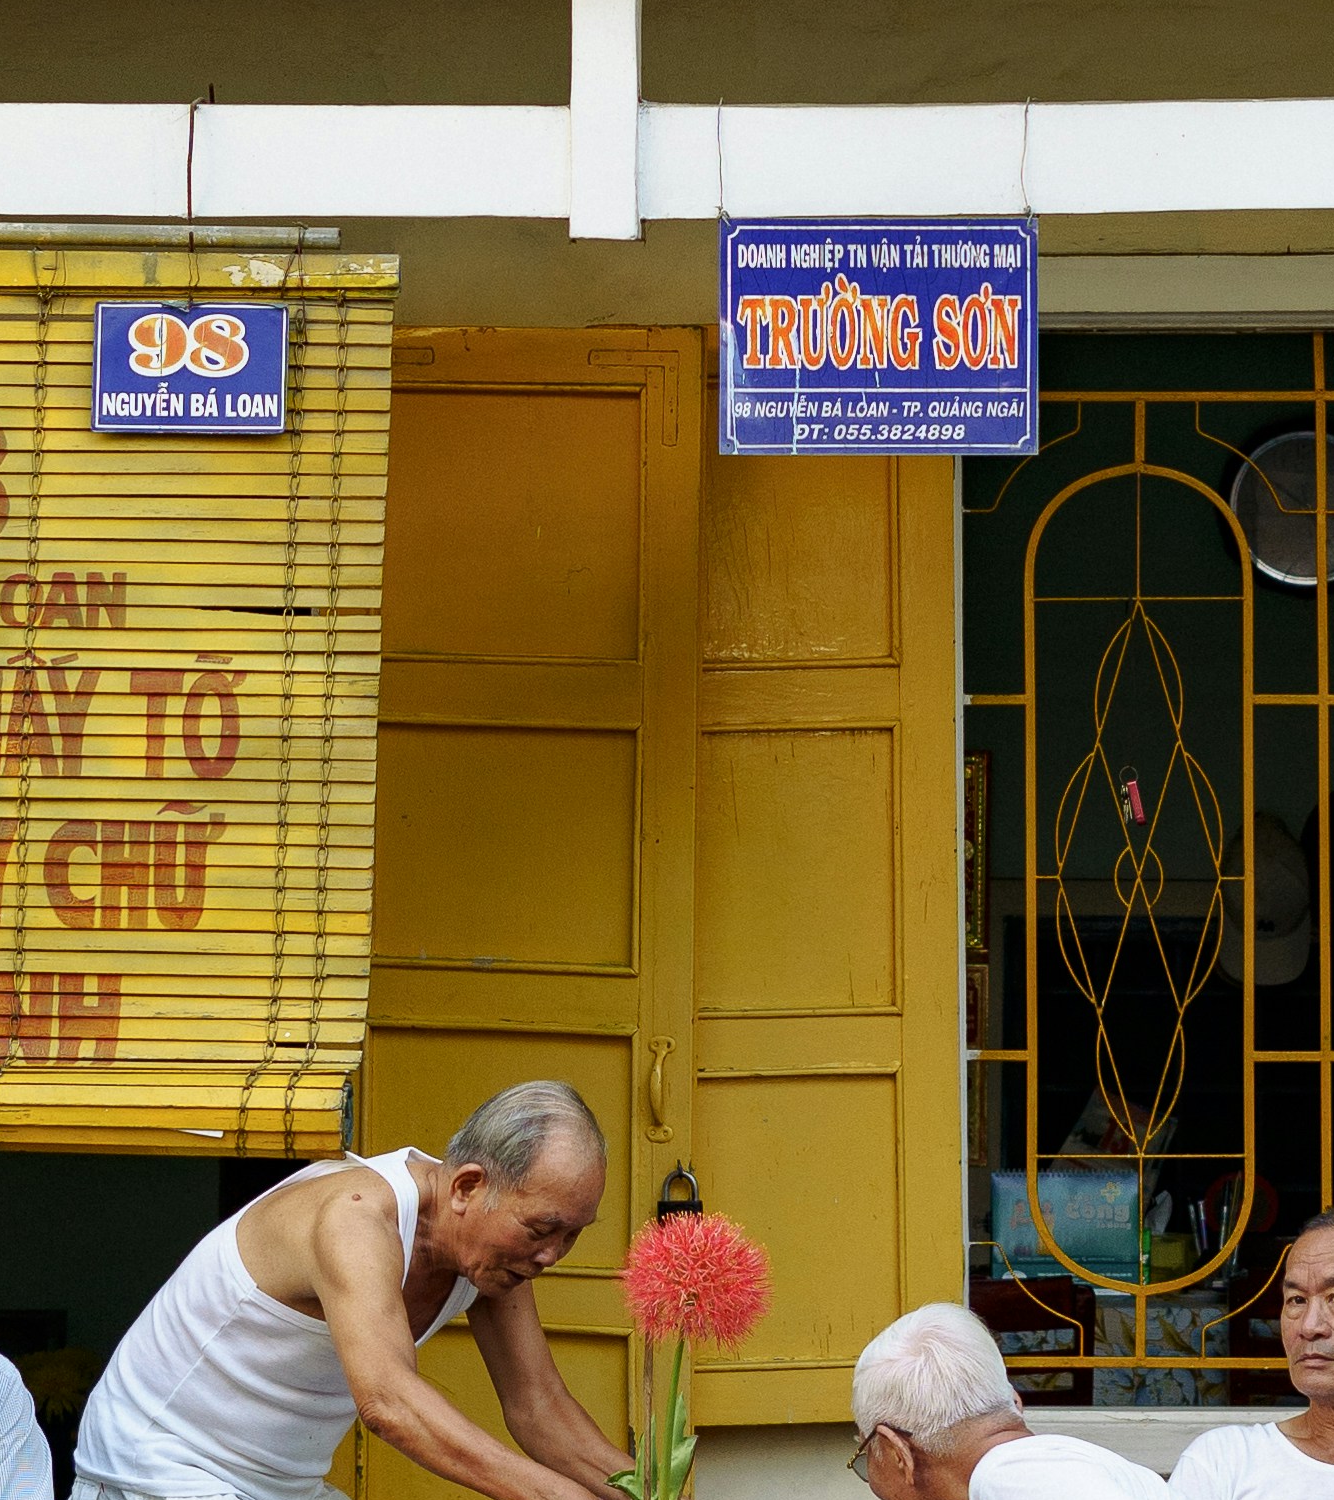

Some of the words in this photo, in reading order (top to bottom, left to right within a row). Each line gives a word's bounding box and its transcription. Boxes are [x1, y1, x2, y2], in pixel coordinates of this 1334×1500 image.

[737, 243, 786, 269] DOANH
[791, 238, 842, 273] NGHIỆP
[848, 243, 867, 269] TN
[871, 239, 900, 273] VẬN
[904, 235, 928, 269] TẢI
[933, 240, 990, 269] THƯƠNG
[994, 243, 1021, 273] MẠI
[128, 313, 249, 378] 98
[737, 273, 923, 371] TRƯỜNG
[932, 281, 1022, 371] SƠN
[102, 382, 184, 417] NGUYỄN
[190, 387, 218, 418] BÁ
[225, 393, 278, 418] LOAN
[734, 401, 751, 419] 98
[754, 394, 818, 419] NGUYỄN
[821, 397, 842, 419] BÁ
[847, 401, 890, 419] LOAN
[901, 401, 923, 419] TP.
[929, 395, 982, 420] QUẢNG
[986, 397, 1024, 419] NGÃI
[795, 425, 830, 441] ĐT:
[834, 424, 965, 441] 055.3824898
[130, 653, 247, 778] TỜ
[43, 802, 226, 929] CHỮ
